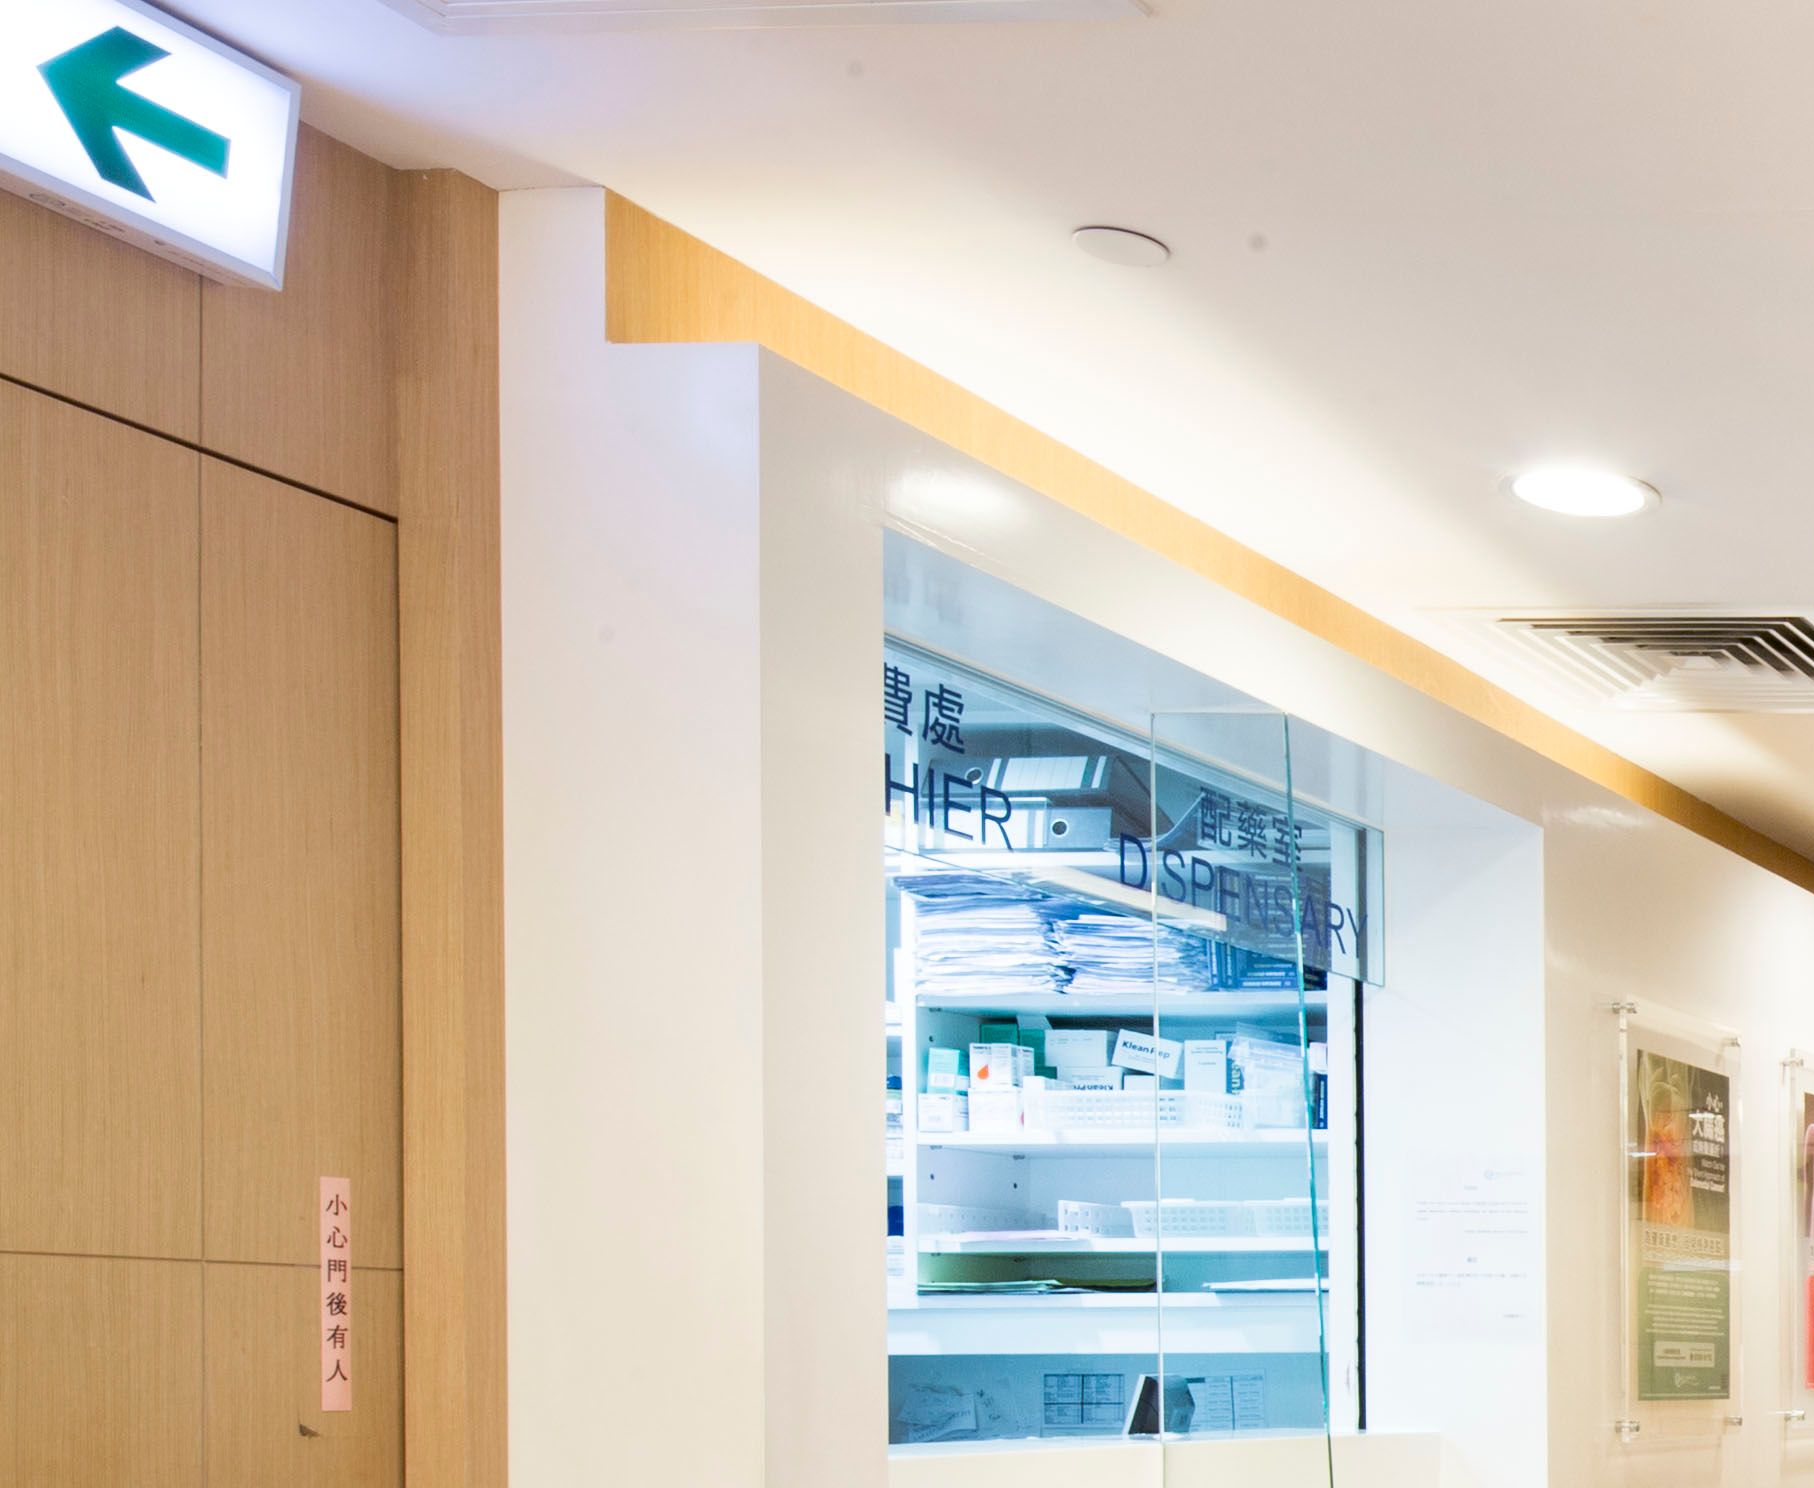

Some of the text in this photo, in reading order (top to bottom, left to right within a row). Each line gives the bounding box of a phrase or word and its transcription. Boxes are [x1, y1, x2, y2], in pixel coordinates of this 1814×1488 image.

[1119, 832, 1368, 959] DSPENSARY
[325, 1193, 349, 1383] 小心門後有人
